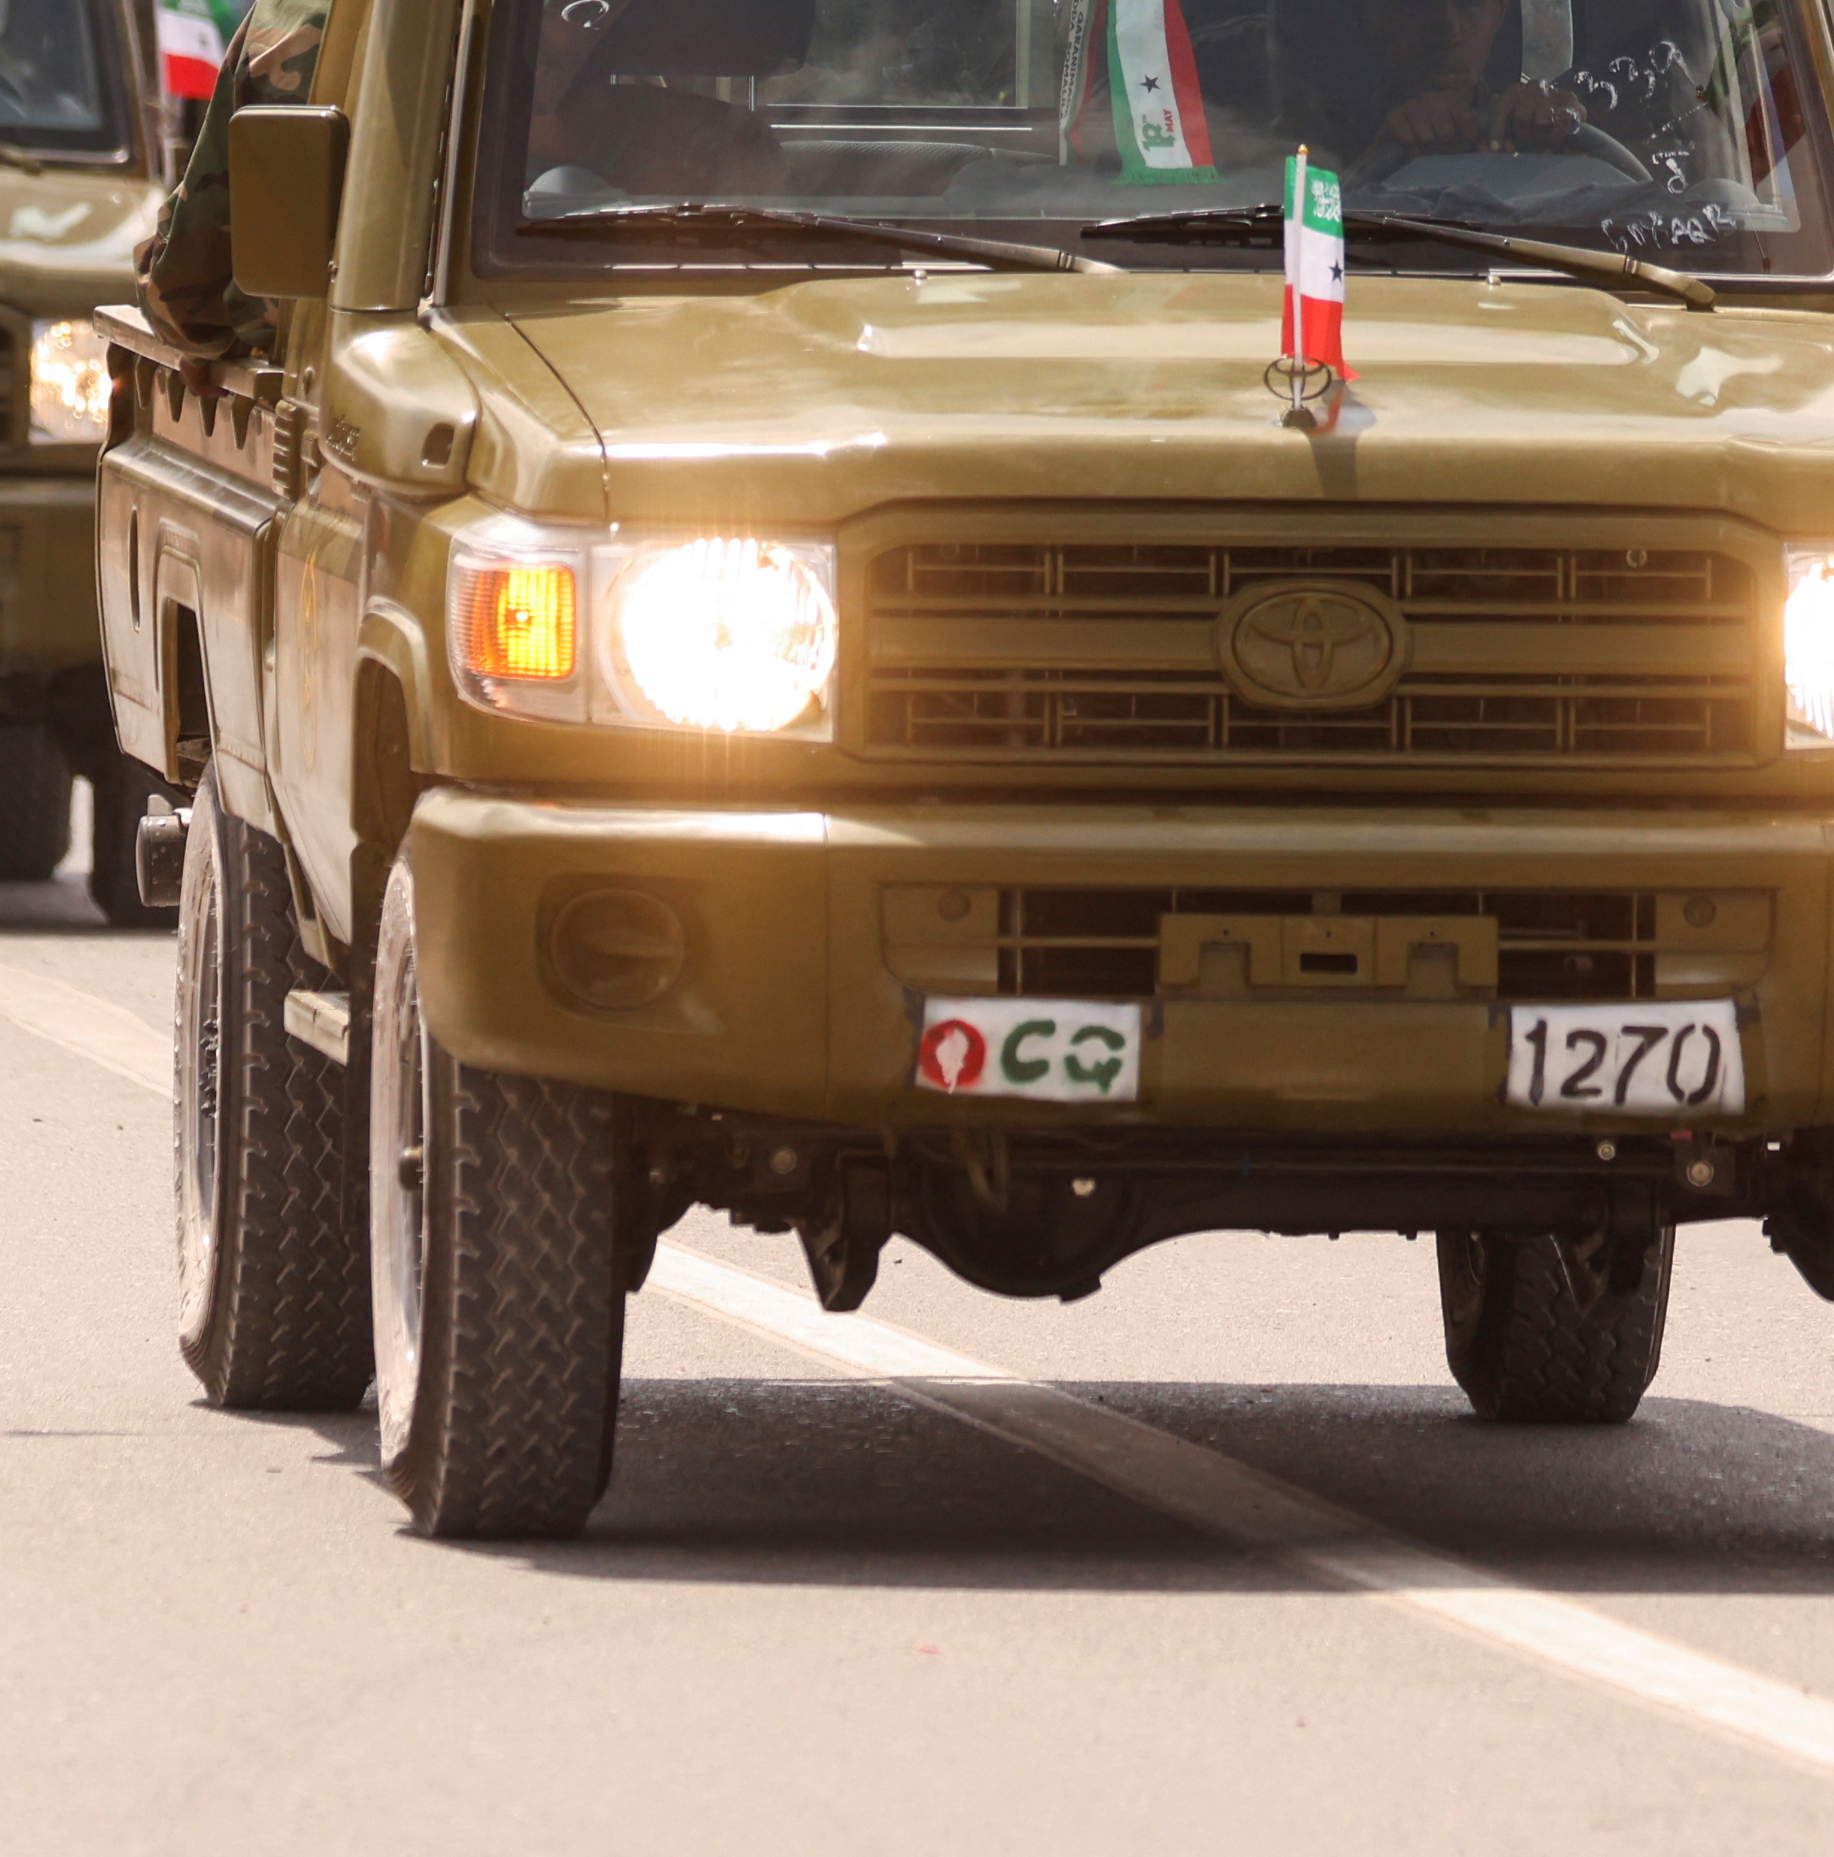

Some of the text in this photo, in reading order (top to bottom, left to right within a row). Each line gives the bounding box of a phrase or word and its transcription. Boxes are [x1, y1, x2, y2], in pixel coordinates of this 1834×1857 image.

[1162, 108, 1175, 133] MAY
[1000, 1019, 1126, 1095] CQ
[1524, 1017, 1721, 1107] 1270
